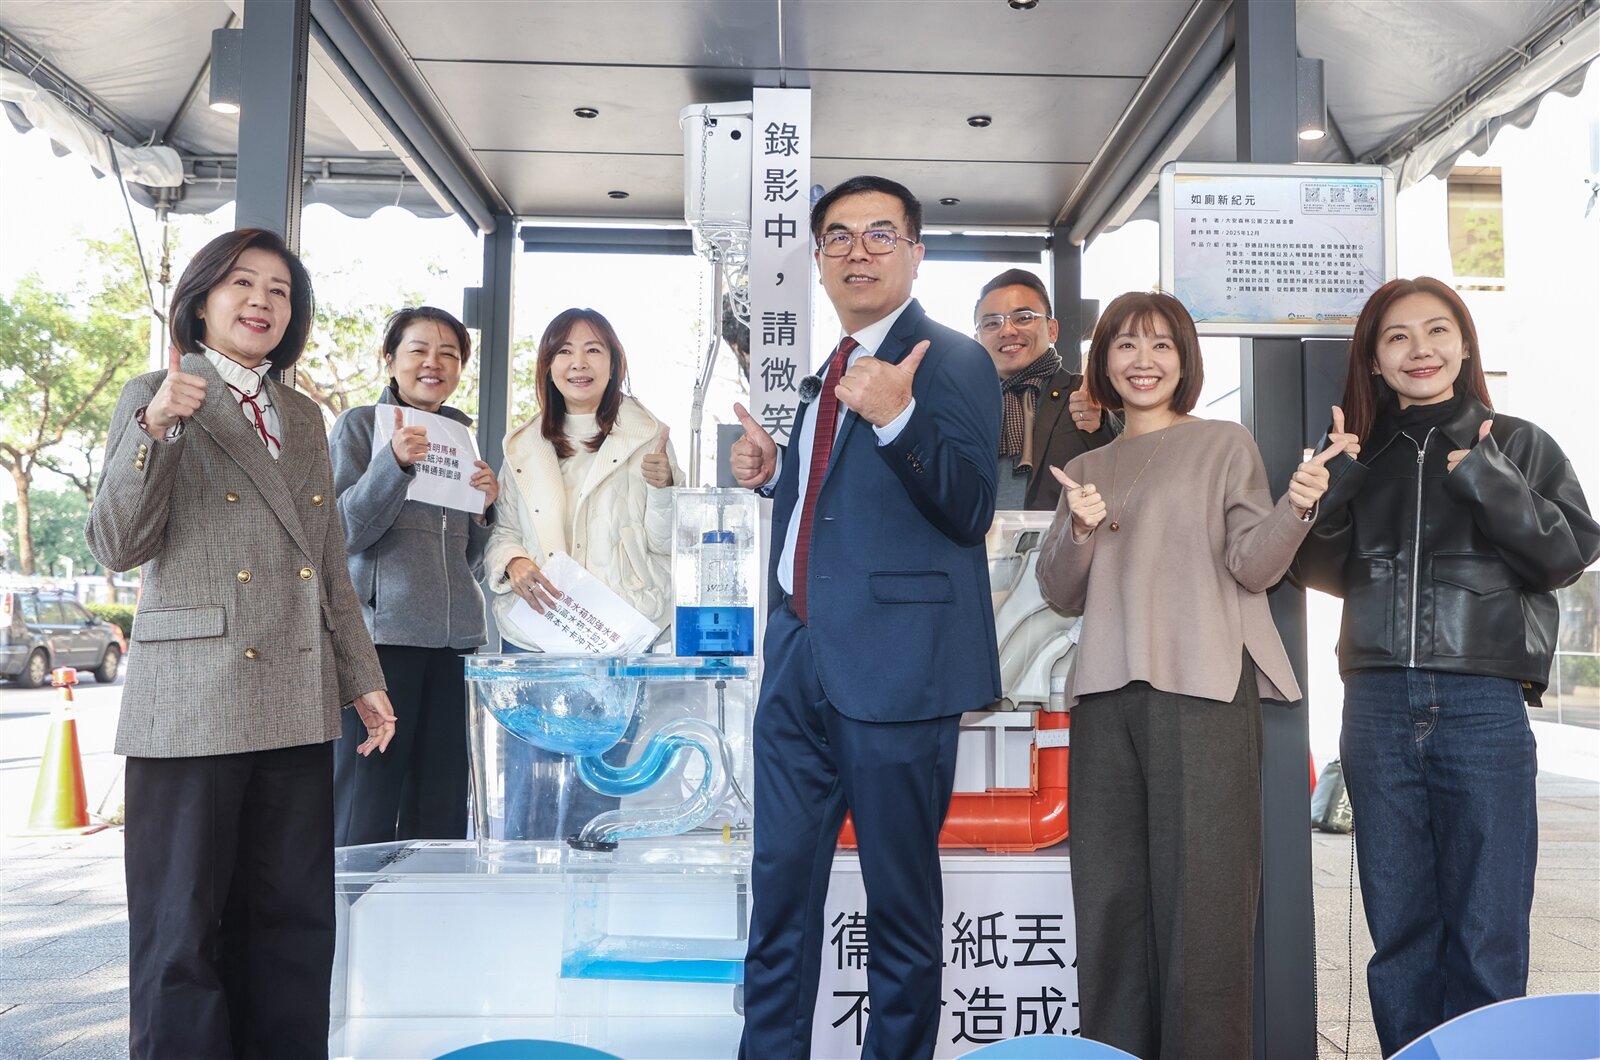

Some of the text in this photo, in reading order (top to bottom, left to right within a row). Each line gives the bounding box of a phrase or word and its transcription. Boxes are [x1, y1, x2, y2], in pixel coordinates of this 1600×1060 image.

[1190, 194, 1257, 206] 如廁新紀元
[760, 121, 801, 438] 錄影中，請微笑
[424, 453, 460, 469] 紙沖馬桶
[832, 986, 1080, 1046] 不造成
